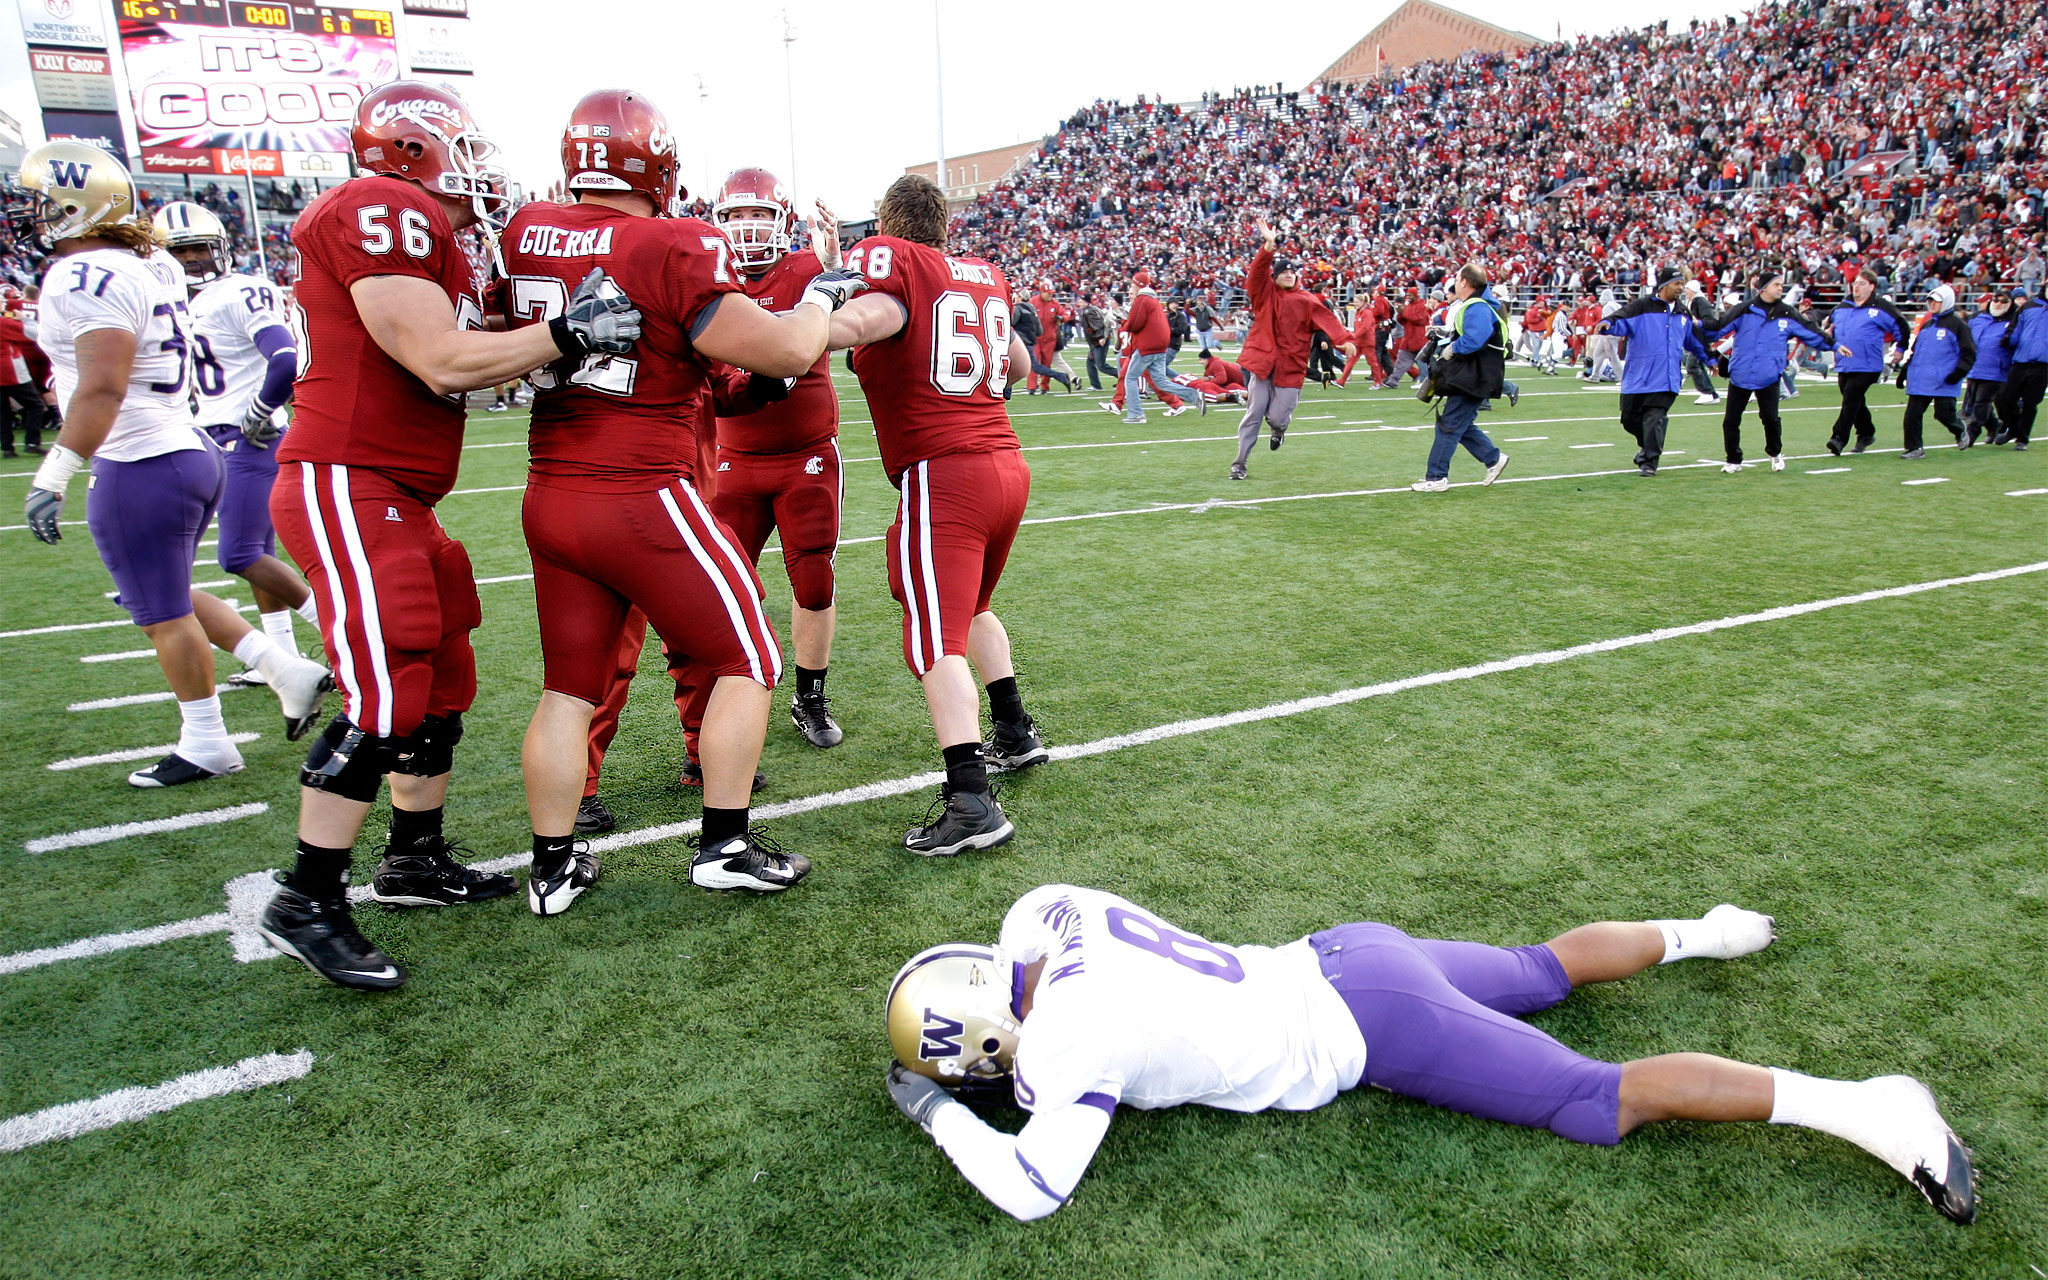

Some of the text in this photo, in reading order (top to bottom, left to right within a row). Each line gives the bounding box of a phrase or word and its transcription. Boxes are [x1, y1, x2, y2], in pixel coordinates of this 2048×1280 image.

[122, 1, 144, 18] 16
[245, 6, 287, 26] 0:00
[25, 30, 104, 43] DODGE DEALERS
[33, 22, 92, 34] NORTHWEST
[322, 16, 352, 35] 6 0
[375, 20, 394, 37] 13
[34, 53, 65, 71] KXLY
[199, 35, 323, 73] IT'S
[141, 82, 374, 130] GOOD
[371, 99, 462, 130] Cougars
[592, 125, 610, 137] RS
[576, 142, 609, 169] 72
[48, 158, 93, 190] W
[357, 204, 432, 259] 56
[518, 225, 614, 258] GUERRA
[847, 245, 893, 280] 68
[69, 262, 115, 297] 37
[240, 286, 274, 314] 28
[929, 290, 1012, 399] 68
[193, 334, 226, 397] 8
[1105, 907, 1245, 984] 8
[919, 1006, 966, 1062] W
